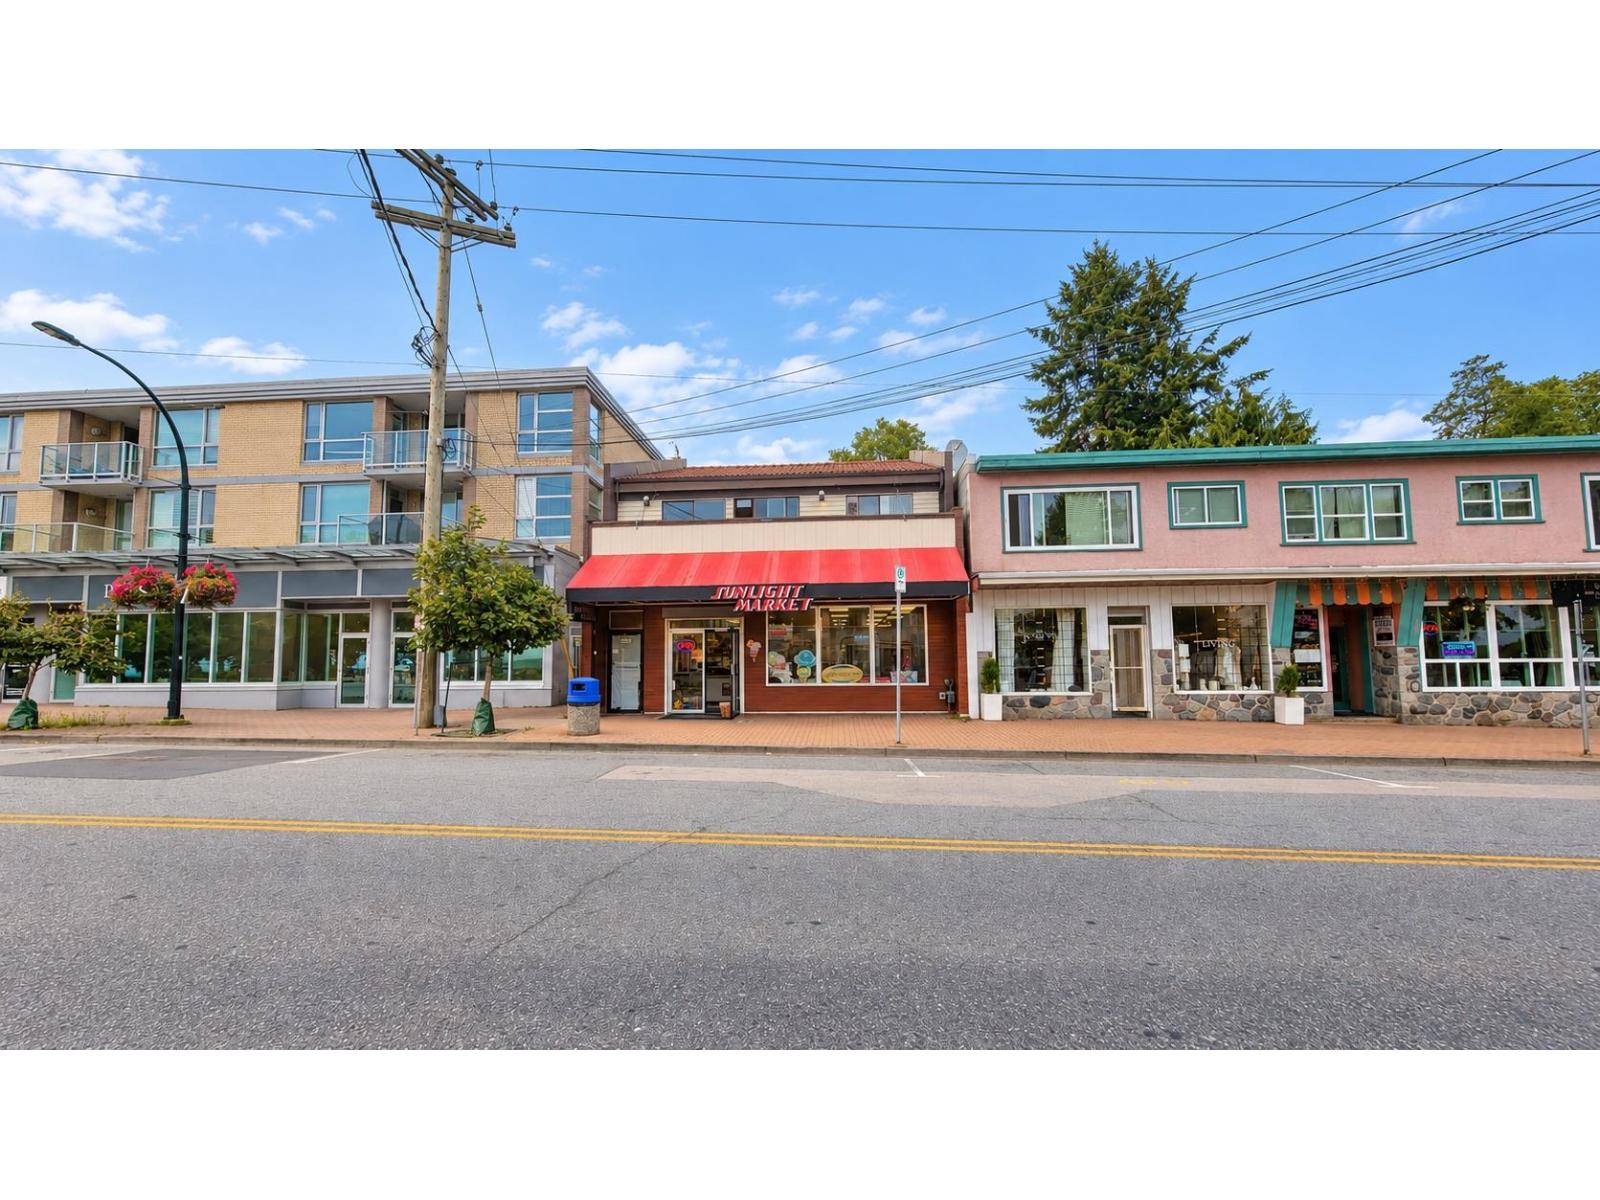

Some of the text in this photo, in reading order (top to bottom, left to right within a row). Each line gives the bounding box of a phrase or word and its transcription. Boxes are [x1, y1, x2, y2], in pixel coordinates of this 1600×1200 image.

[710, 585, 804, 599] SUNLIGHT
[733, 598, 814, 612] MARKET
[1202, 640, 1236, 648] LIVING
